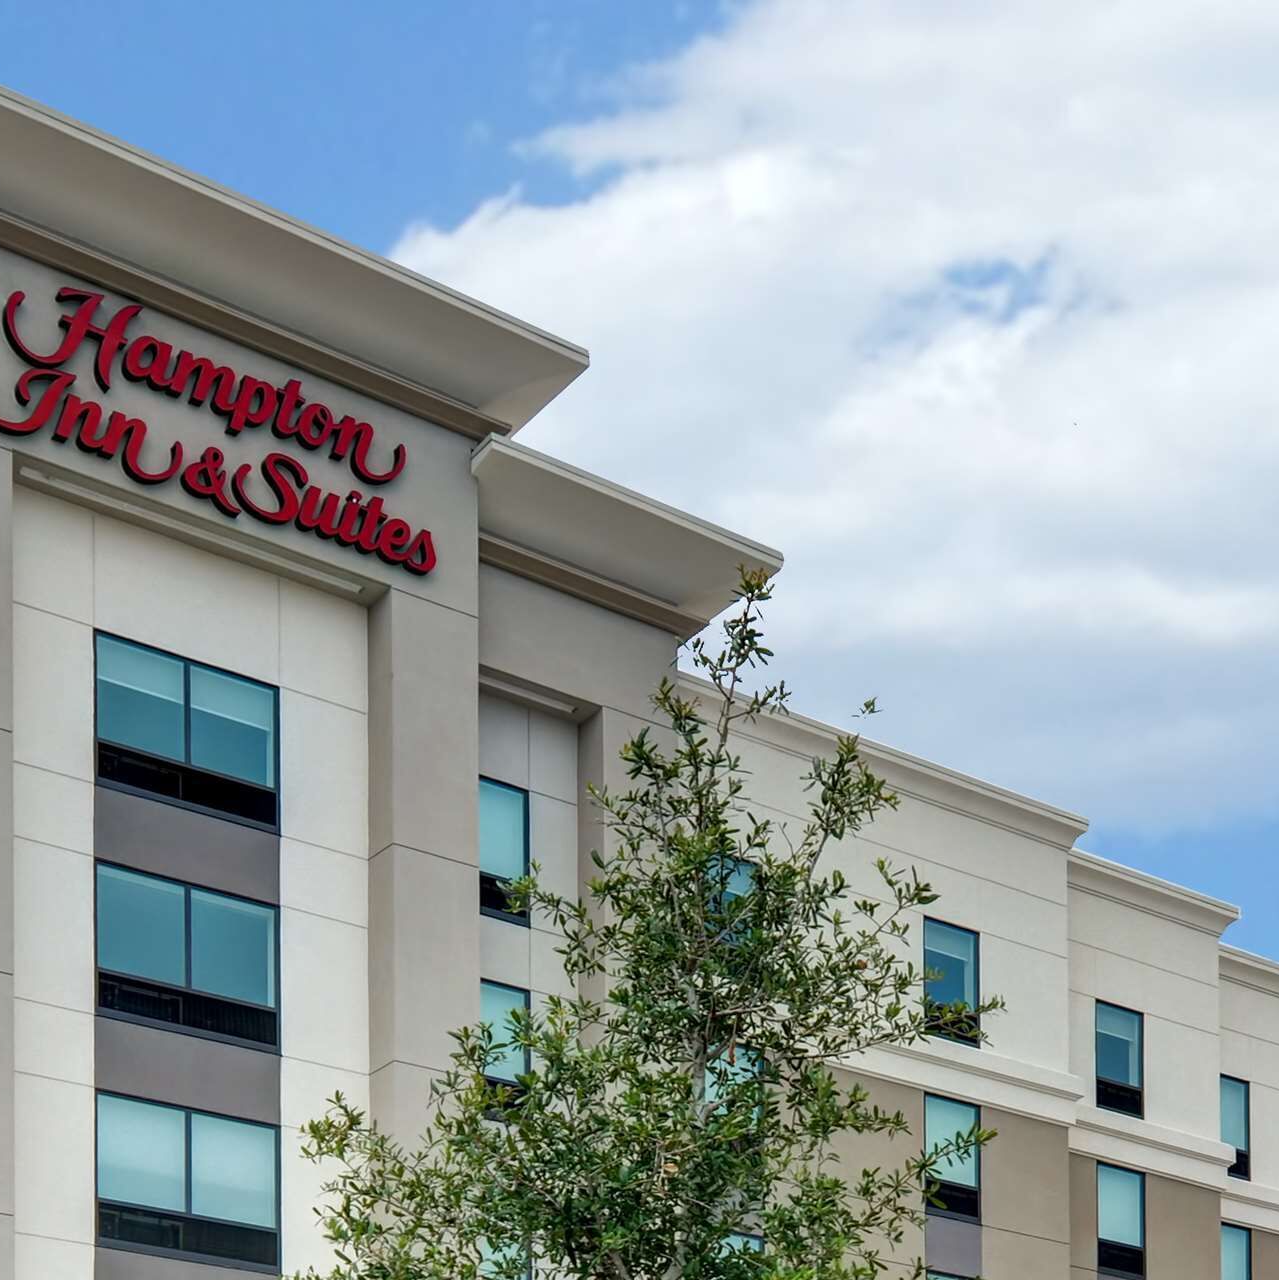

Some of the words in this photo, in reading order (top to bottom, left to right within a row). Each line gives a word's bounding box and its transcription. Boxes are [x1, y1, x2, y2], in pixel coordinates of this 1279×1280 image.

[3, 286, 407, 487] Hampton
[180, 446, 242, 520] &
[231, 452, 438, 577] Suites
